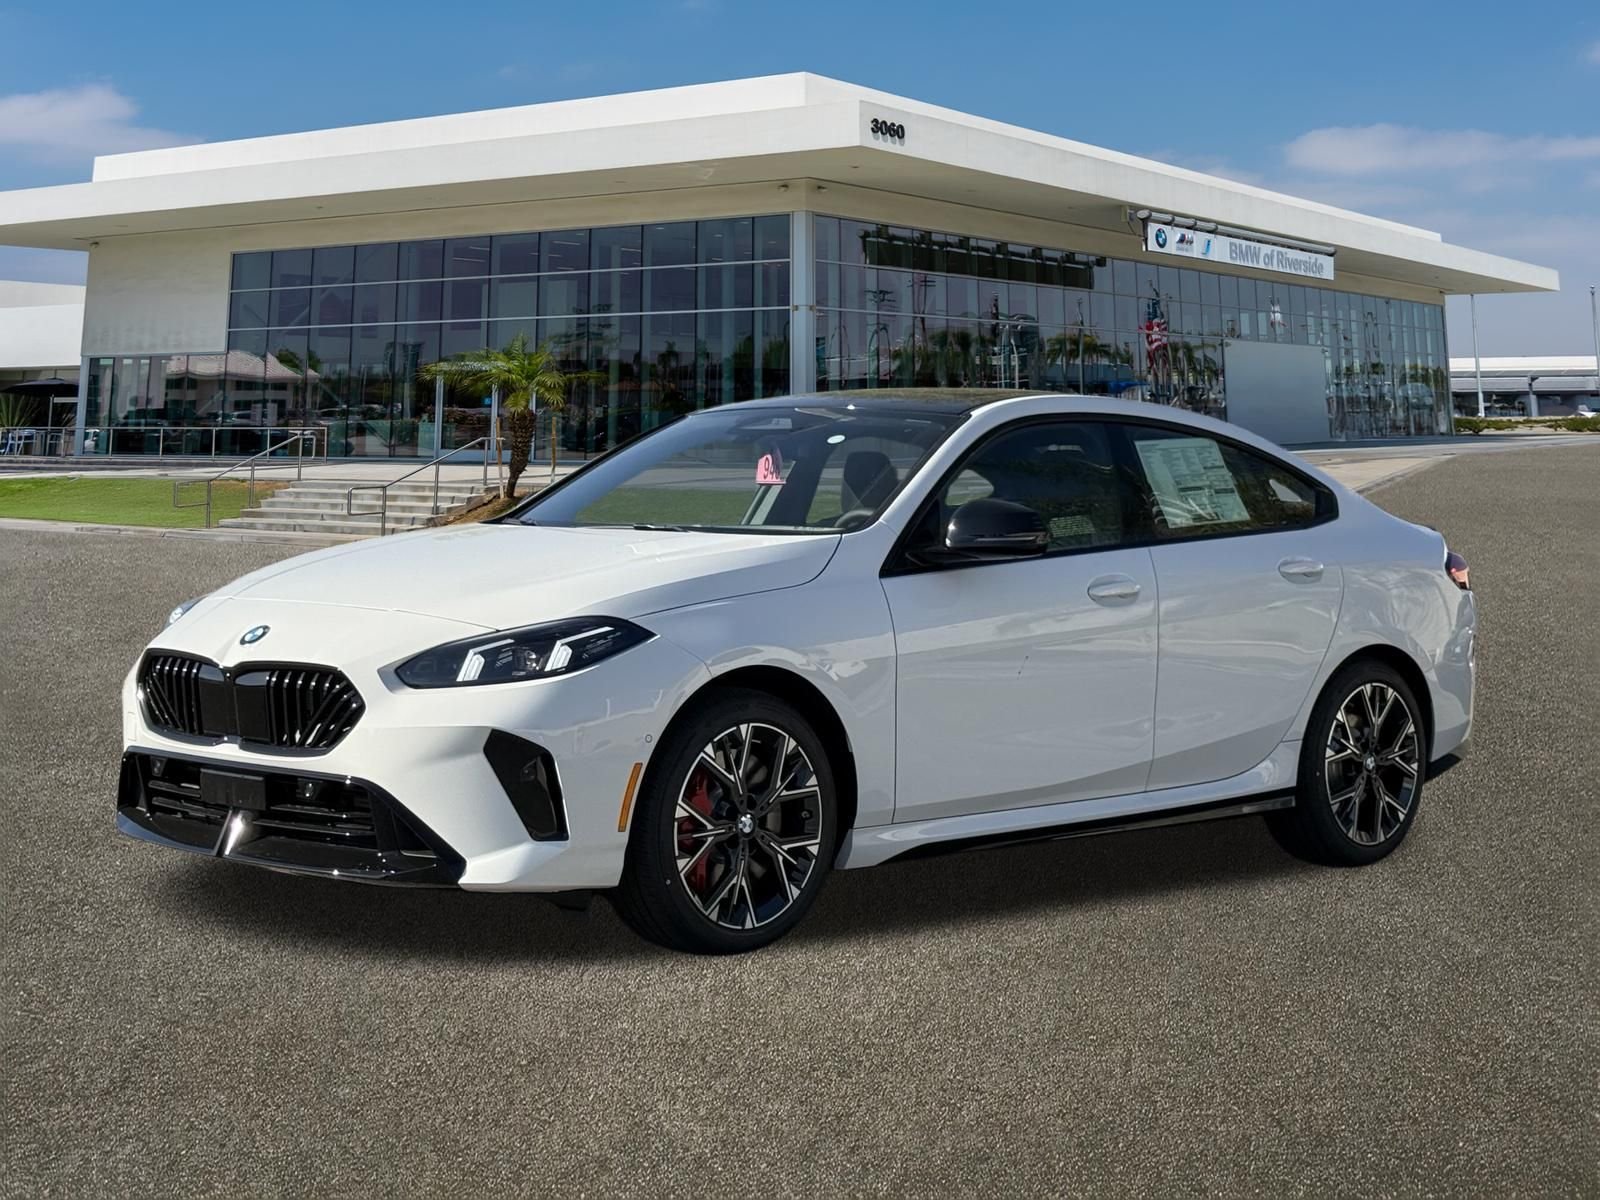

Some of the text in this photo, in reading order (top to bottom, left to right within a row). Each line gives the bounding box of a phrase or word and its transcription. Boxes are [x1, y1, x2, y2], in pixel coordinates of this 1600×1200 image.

[870, 118, 905, 139] 3060
[1229, 241, 1324, 274] BMW of Riverside
